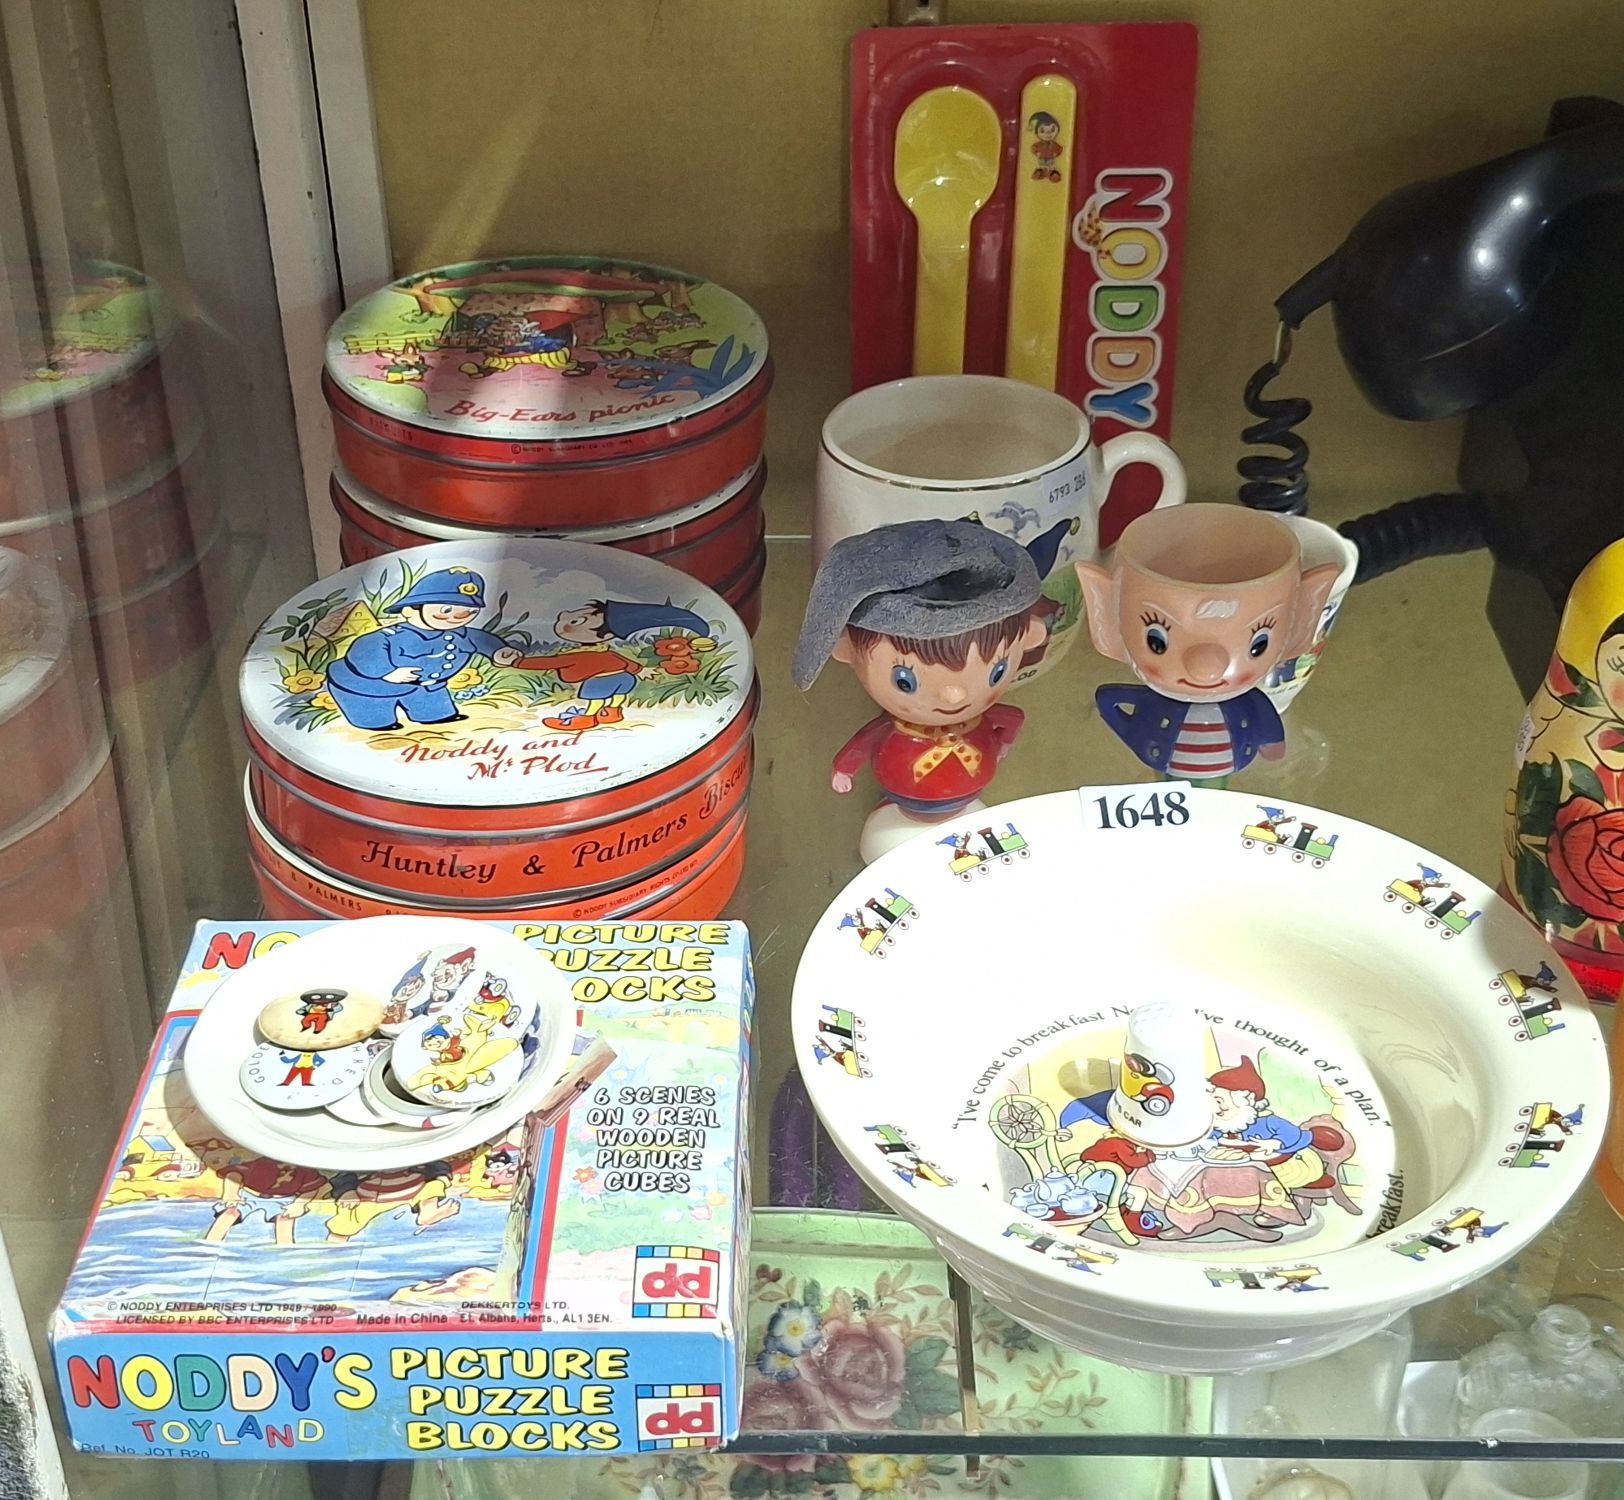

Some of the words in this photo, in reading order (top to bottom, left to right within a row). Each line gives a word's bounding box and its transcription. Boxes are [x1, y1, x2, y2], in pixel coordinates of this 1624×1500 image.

[1086, 171, 1168, 425] NODDY
[444, 399, 577, 423] Big-Ears
[588, 394, 676, 423] picnic
[1049, 483, 1070, 504] 6793
[400, 737, 509, 763] Noddy
[522, 730, 584, 751] and
[520, 752, 602, 776] Plod
[1092, 791, 1190, 829] 1648
[360, 840, 497, 884] Huntley
[522, 855, 547, 877] &
[573, 812, 689, 872] Palmers
[307, 882, 362, 911] PALMERS
[583, 902, 608, 915] NODDY
[512, 923, 731, 945] PICTURE
[571, 975, 717, 1002] OCKS
[972, 1059, 1005, 1095] come
[1001, 1045, 1022, 1059] to
[1016, 1011, 1105, 1047] breakfast
[1234, 1019, 1310, 1056] thought
[1314, 1058, 1342, 1073] of
[1334, 1075, 1349, 1087] a
[593, 1087, 610, 1105] 6
[618, 1085, 716, 1106] SCENES
[587, 1107, 624, 1126] ON
[632, 1107, 650, 1125] 9
[658, 1106, 721, 1128] REAL
[1123, 1110, 1142, 1128] CAR
[596, 1128, 706, 1149] WOODEN
[596, 1149, 703, 1171] PICTURE
[604, 1171, 691, 1194] CUBES
[642, 1262, 711, 1299] dd
[119, 1302, 163, 1311] NODDY
[165, 1302, 247, 1311] ENTERPRISES
[250, 1302, 273, 1312] LTD
[461, 1301, 541, 1310] DEKKERTOYS
[545, 1301, 570, 1310] LTD.
[115, 1315, 175, 1325] LICENSED
[178, 1316, 193, 1325] BY
[199, 1315, 223, 1325] BBC
[225, 1315, 308, 1325] ENTERPRISES
[311, 1315, 334, 1325] LTD
[356, 1313, 391, 1325] Made
[395, 1313, 408, 1324] in
[410, 1312, 449, 1324] China
[478, 1313, 520, 1324] Albans,
[562, 1313, 582, 1323] AL1
[587, 1313, 613, 1323] 3EN.
[390, 1347, 630, 1380] PICTURE
[67, 1345, 377, 1412] NODDY'S
[408, 1384, 615, 1416] PUZZLE
[132, 1413, 325, 1448] TOYLAND
[644, 1402, 715, 1436] dd
[405, 1420, 622, 1450] BLOCKS
[144, 1446, 174, 1457] JOT
[180, 1448, 210, 1459] R20
